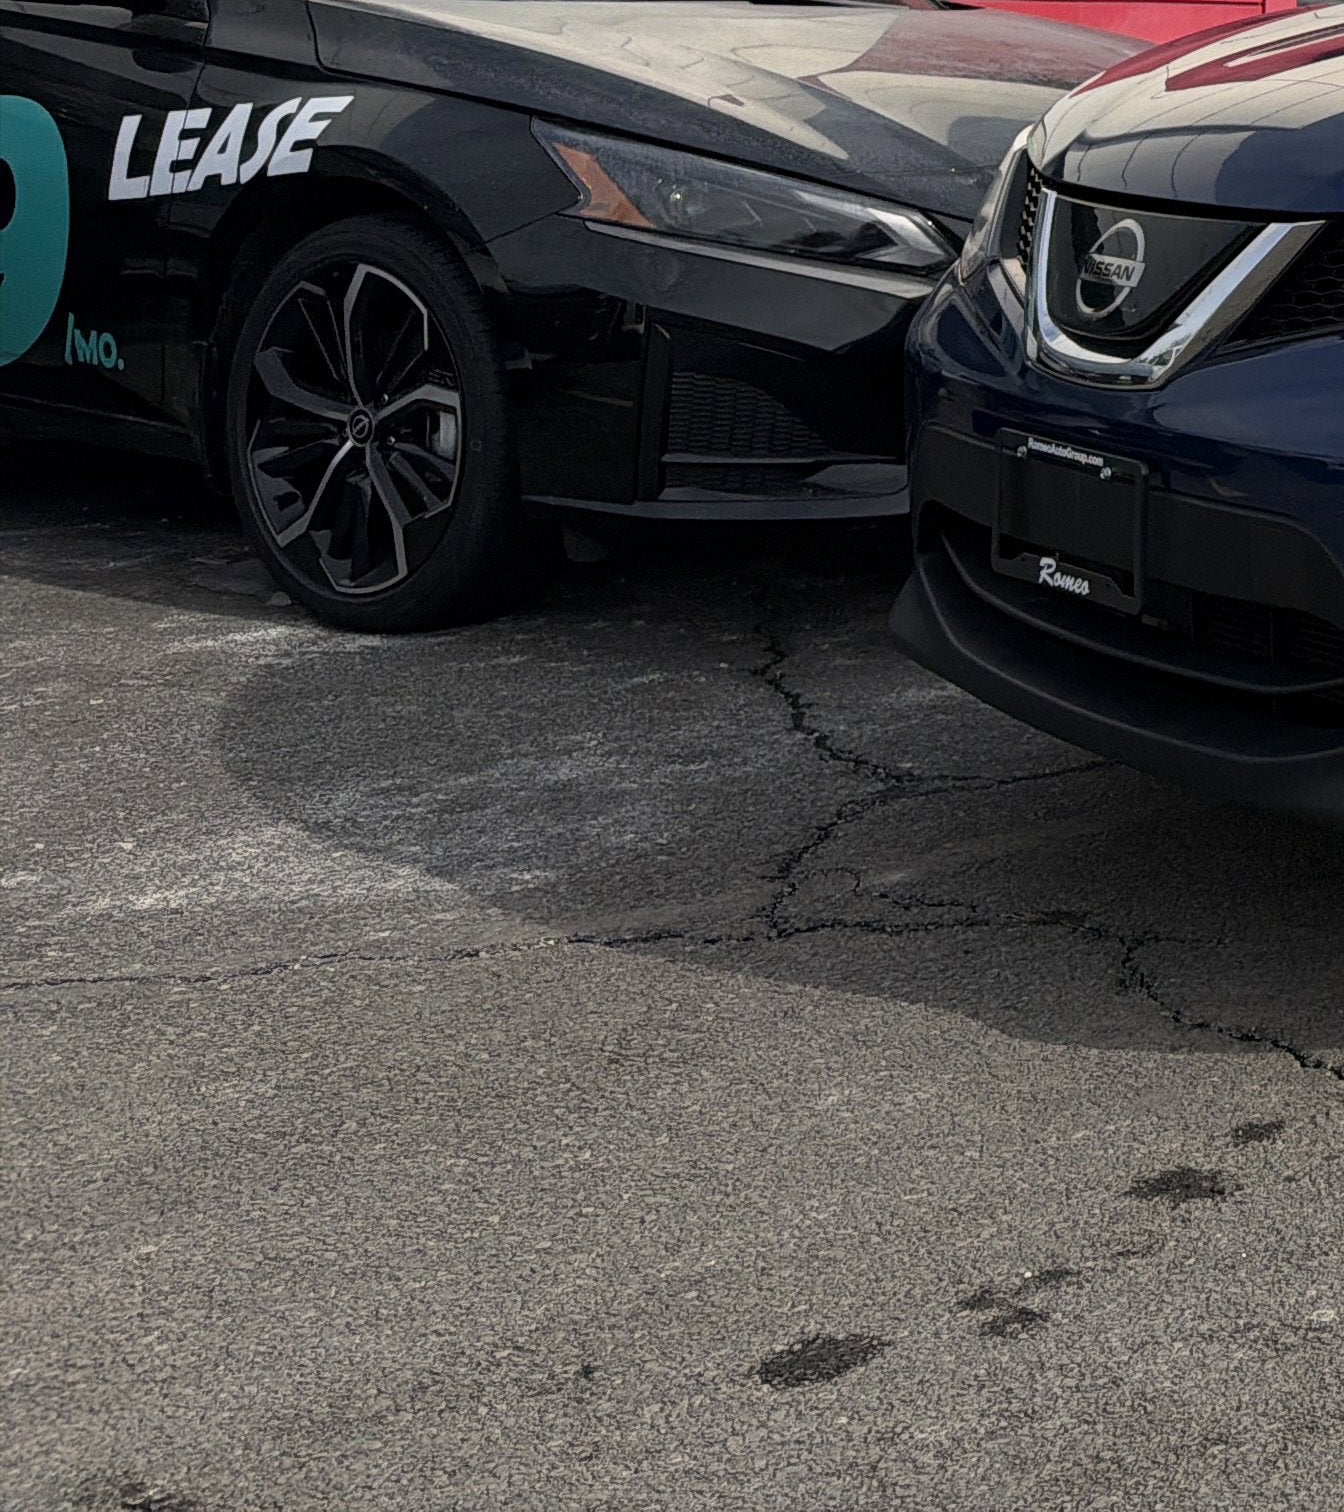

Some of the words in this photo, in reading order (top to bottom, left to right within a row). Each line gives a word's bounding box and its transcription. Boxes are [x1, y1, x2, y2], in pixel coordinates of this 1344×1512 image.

[108, 95, 354, 201] LEASE
[1083, 258, 1136, 282] NISSAN
[65, 312, 125, 371] /MO.
[1028, 437, 1104, 467] RomeoAutoGroup.com
[1038, 557, 1091, 596] Romeo
